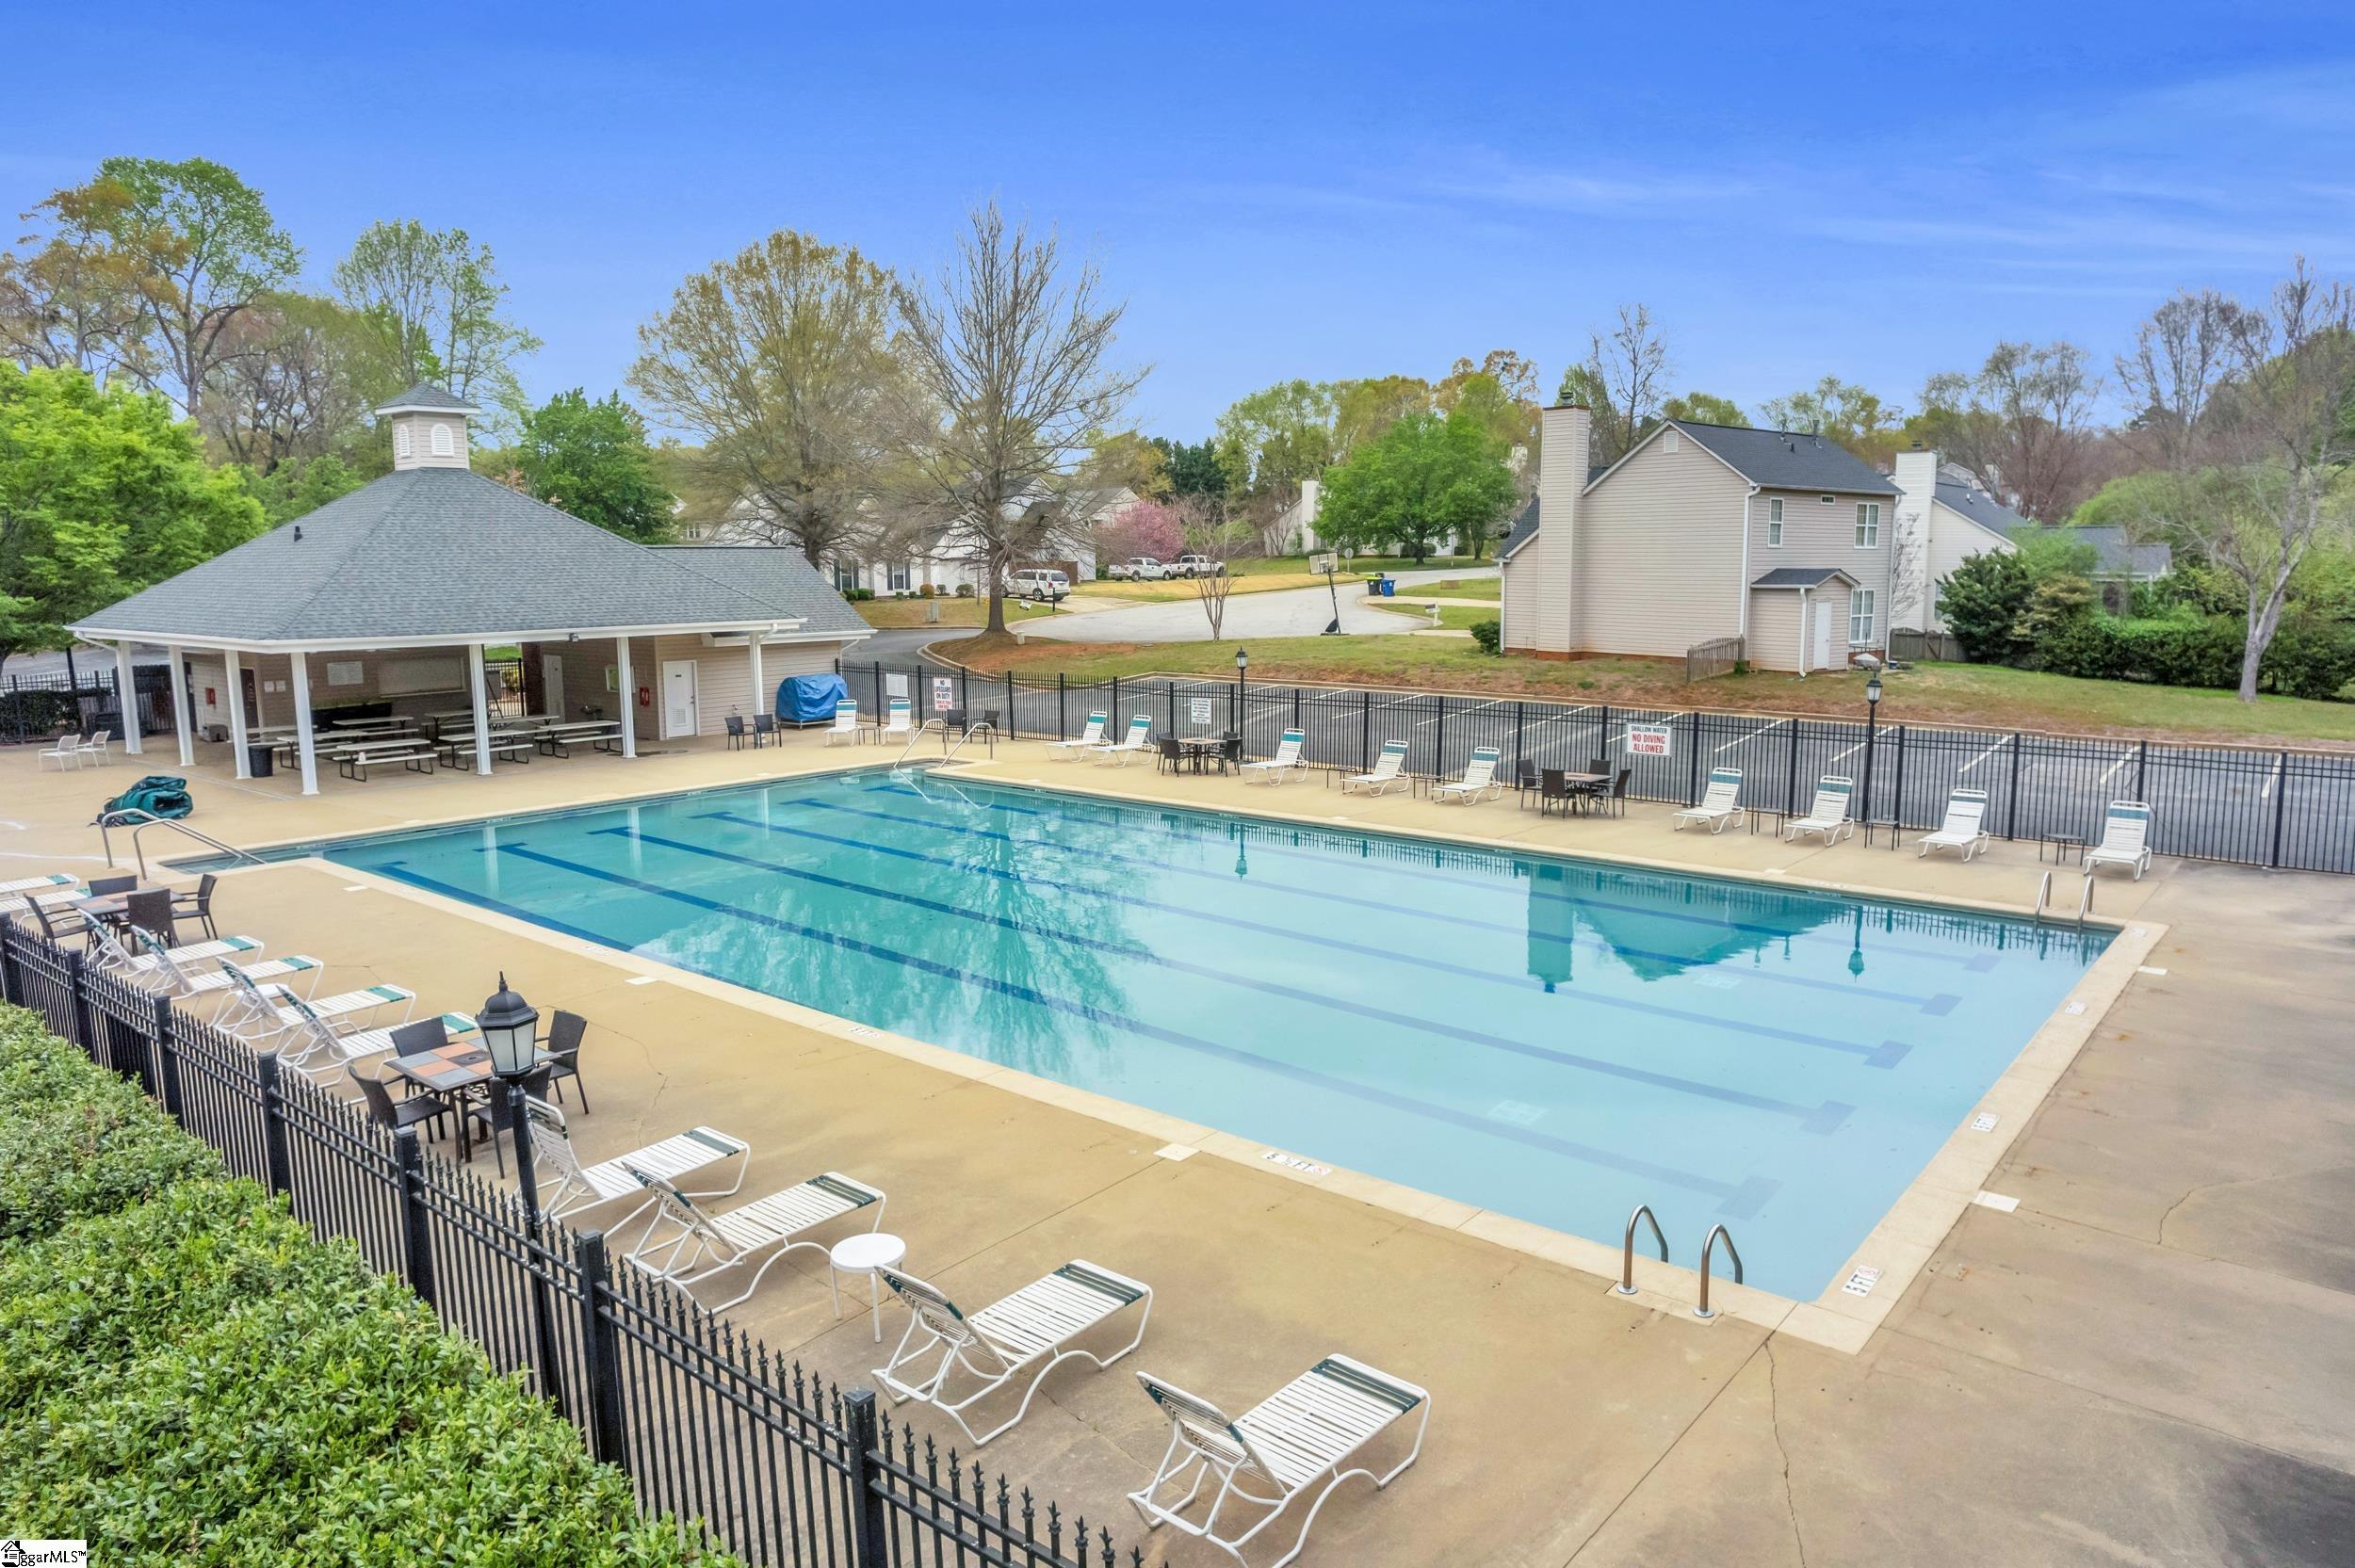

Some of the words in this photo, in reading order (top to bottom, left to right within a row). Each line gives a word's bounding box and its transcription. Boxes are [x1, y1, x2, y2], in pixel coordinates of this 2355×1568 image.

[1632, 734, 1641, 742] NO
[1643, 735, 1665, 744] DIVING
[1632, 743, 1664, 753] ALLOWED
